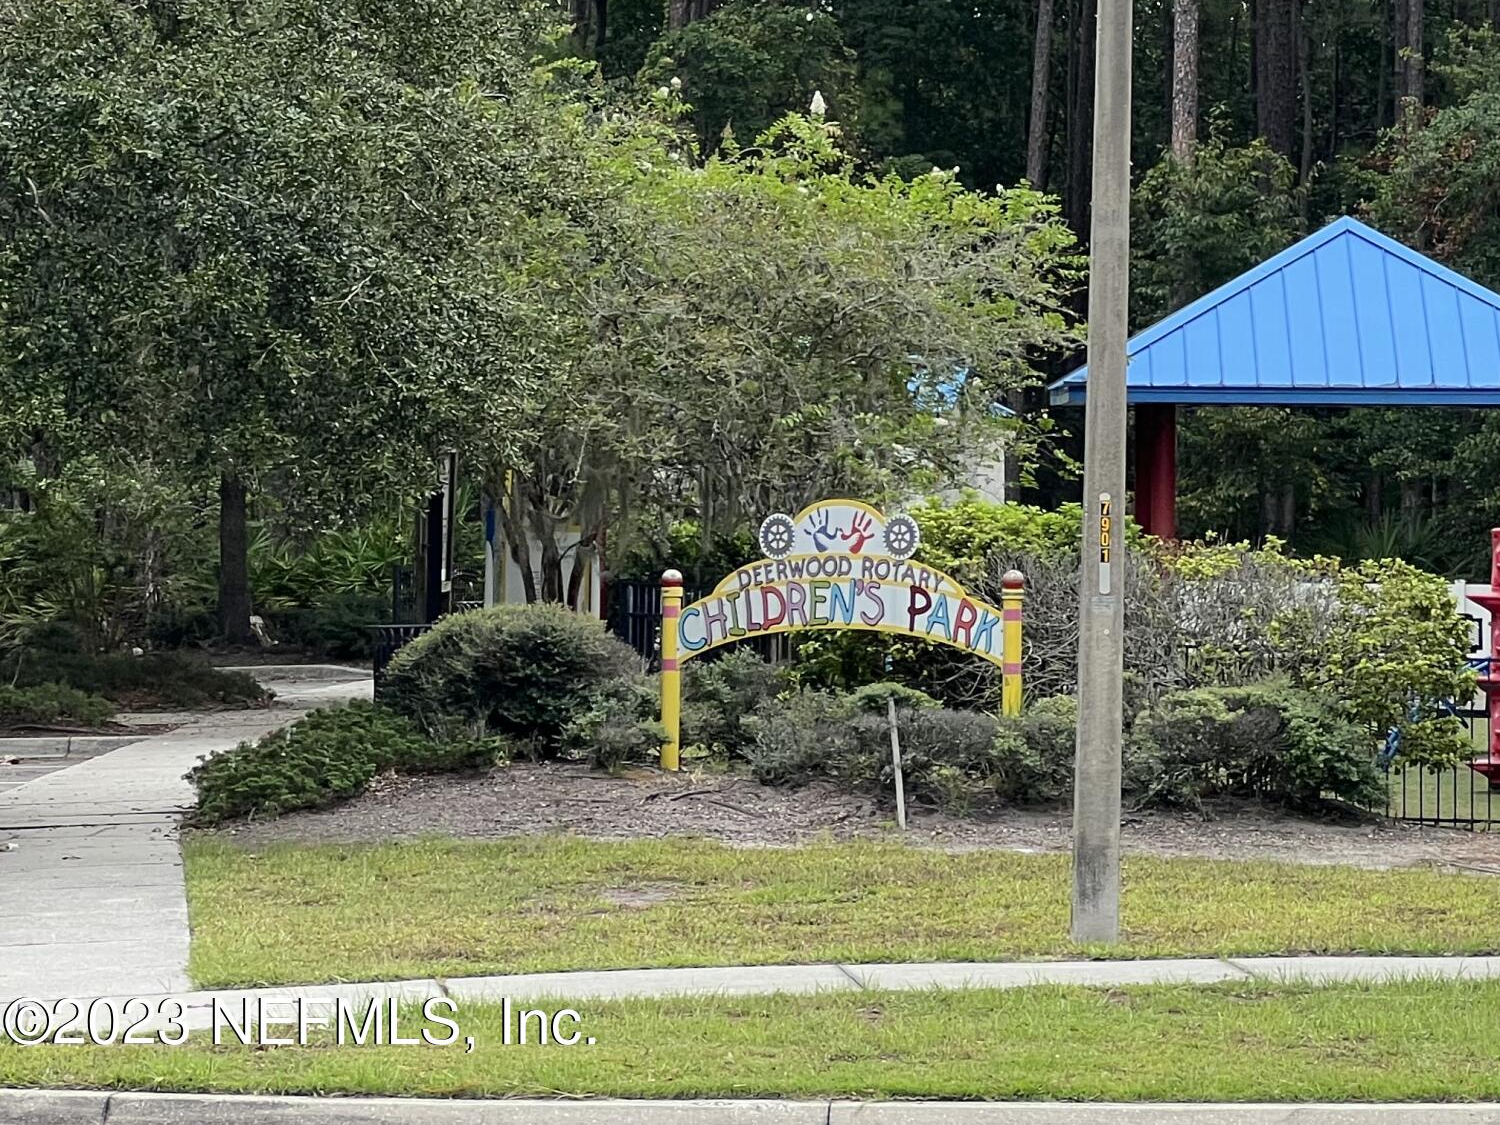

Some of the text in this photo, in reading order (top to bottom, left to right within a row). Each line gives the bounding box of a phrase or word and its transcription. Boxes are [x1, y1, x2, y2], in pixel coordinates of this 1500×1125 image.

[1100, 501, 1111, 563] 7901
[738, 556, 945, 594] DEERWOOD ROTARY
[677, 578, 1000, 654] CHILDREN'S PARK
